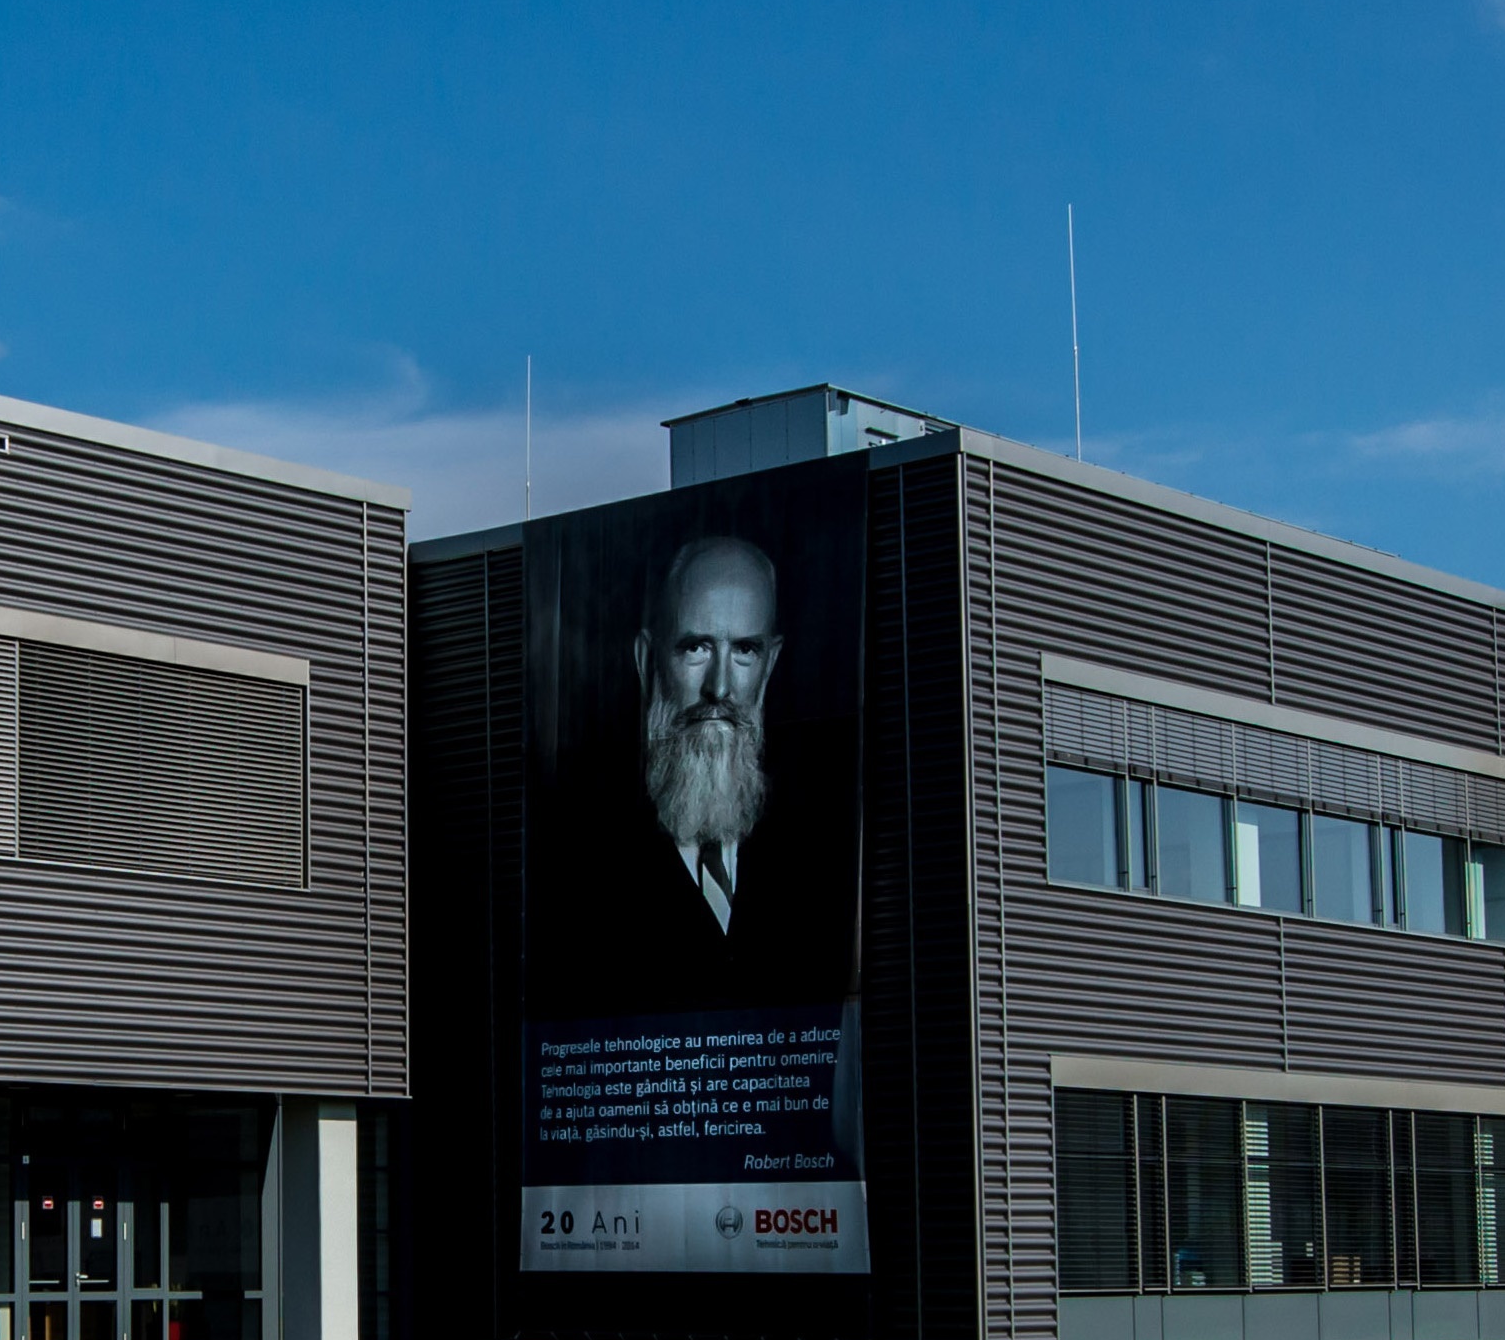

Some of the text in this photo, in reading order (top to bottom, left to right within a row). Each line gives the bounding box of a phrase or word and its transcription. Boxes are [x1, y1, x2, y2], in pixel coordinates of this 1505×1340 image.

[541, 1026, 840, 1058] Progresele tehnologice au menirea de a aduce
[541, 1050, 837, 1077] cele mai importante beneficii pentru omenire.
[541, 1082, 601, 1099] Tehnologia
[605, 1083, 632, 1095] este
[636, 1077, 686, 1097] gândită
[707, 1079, 728, 1091] are
[733, 1075, 810, 1093] capacitatea
[541, 1105, 553, 1119] de
[556, 1109, 562, 1118] a
[566, 1105, 595, 1121] ajuta
[599, 1101, 650, 1116] oamenii
[654, 1101, 668, 1115] să
[723, 1100, 738, 1113] ce
[743, 1100, 751, 1112] e
[757, 1096, 780, 1111] mai
[784, 1095, 808, 1110] bun
[813, 1094, 829, 1109] de
[540, 1127, 548, 1141] la
[658, 1120, 699, 1137] astfel,
[705, 1120, 766, 1136] fericirea.
[744, 1152, 834, 1169] Robert Bosch
[541, 1210, 639, 1234] 20 Ani
[755, 1209, 838, 1234] BOSCH
